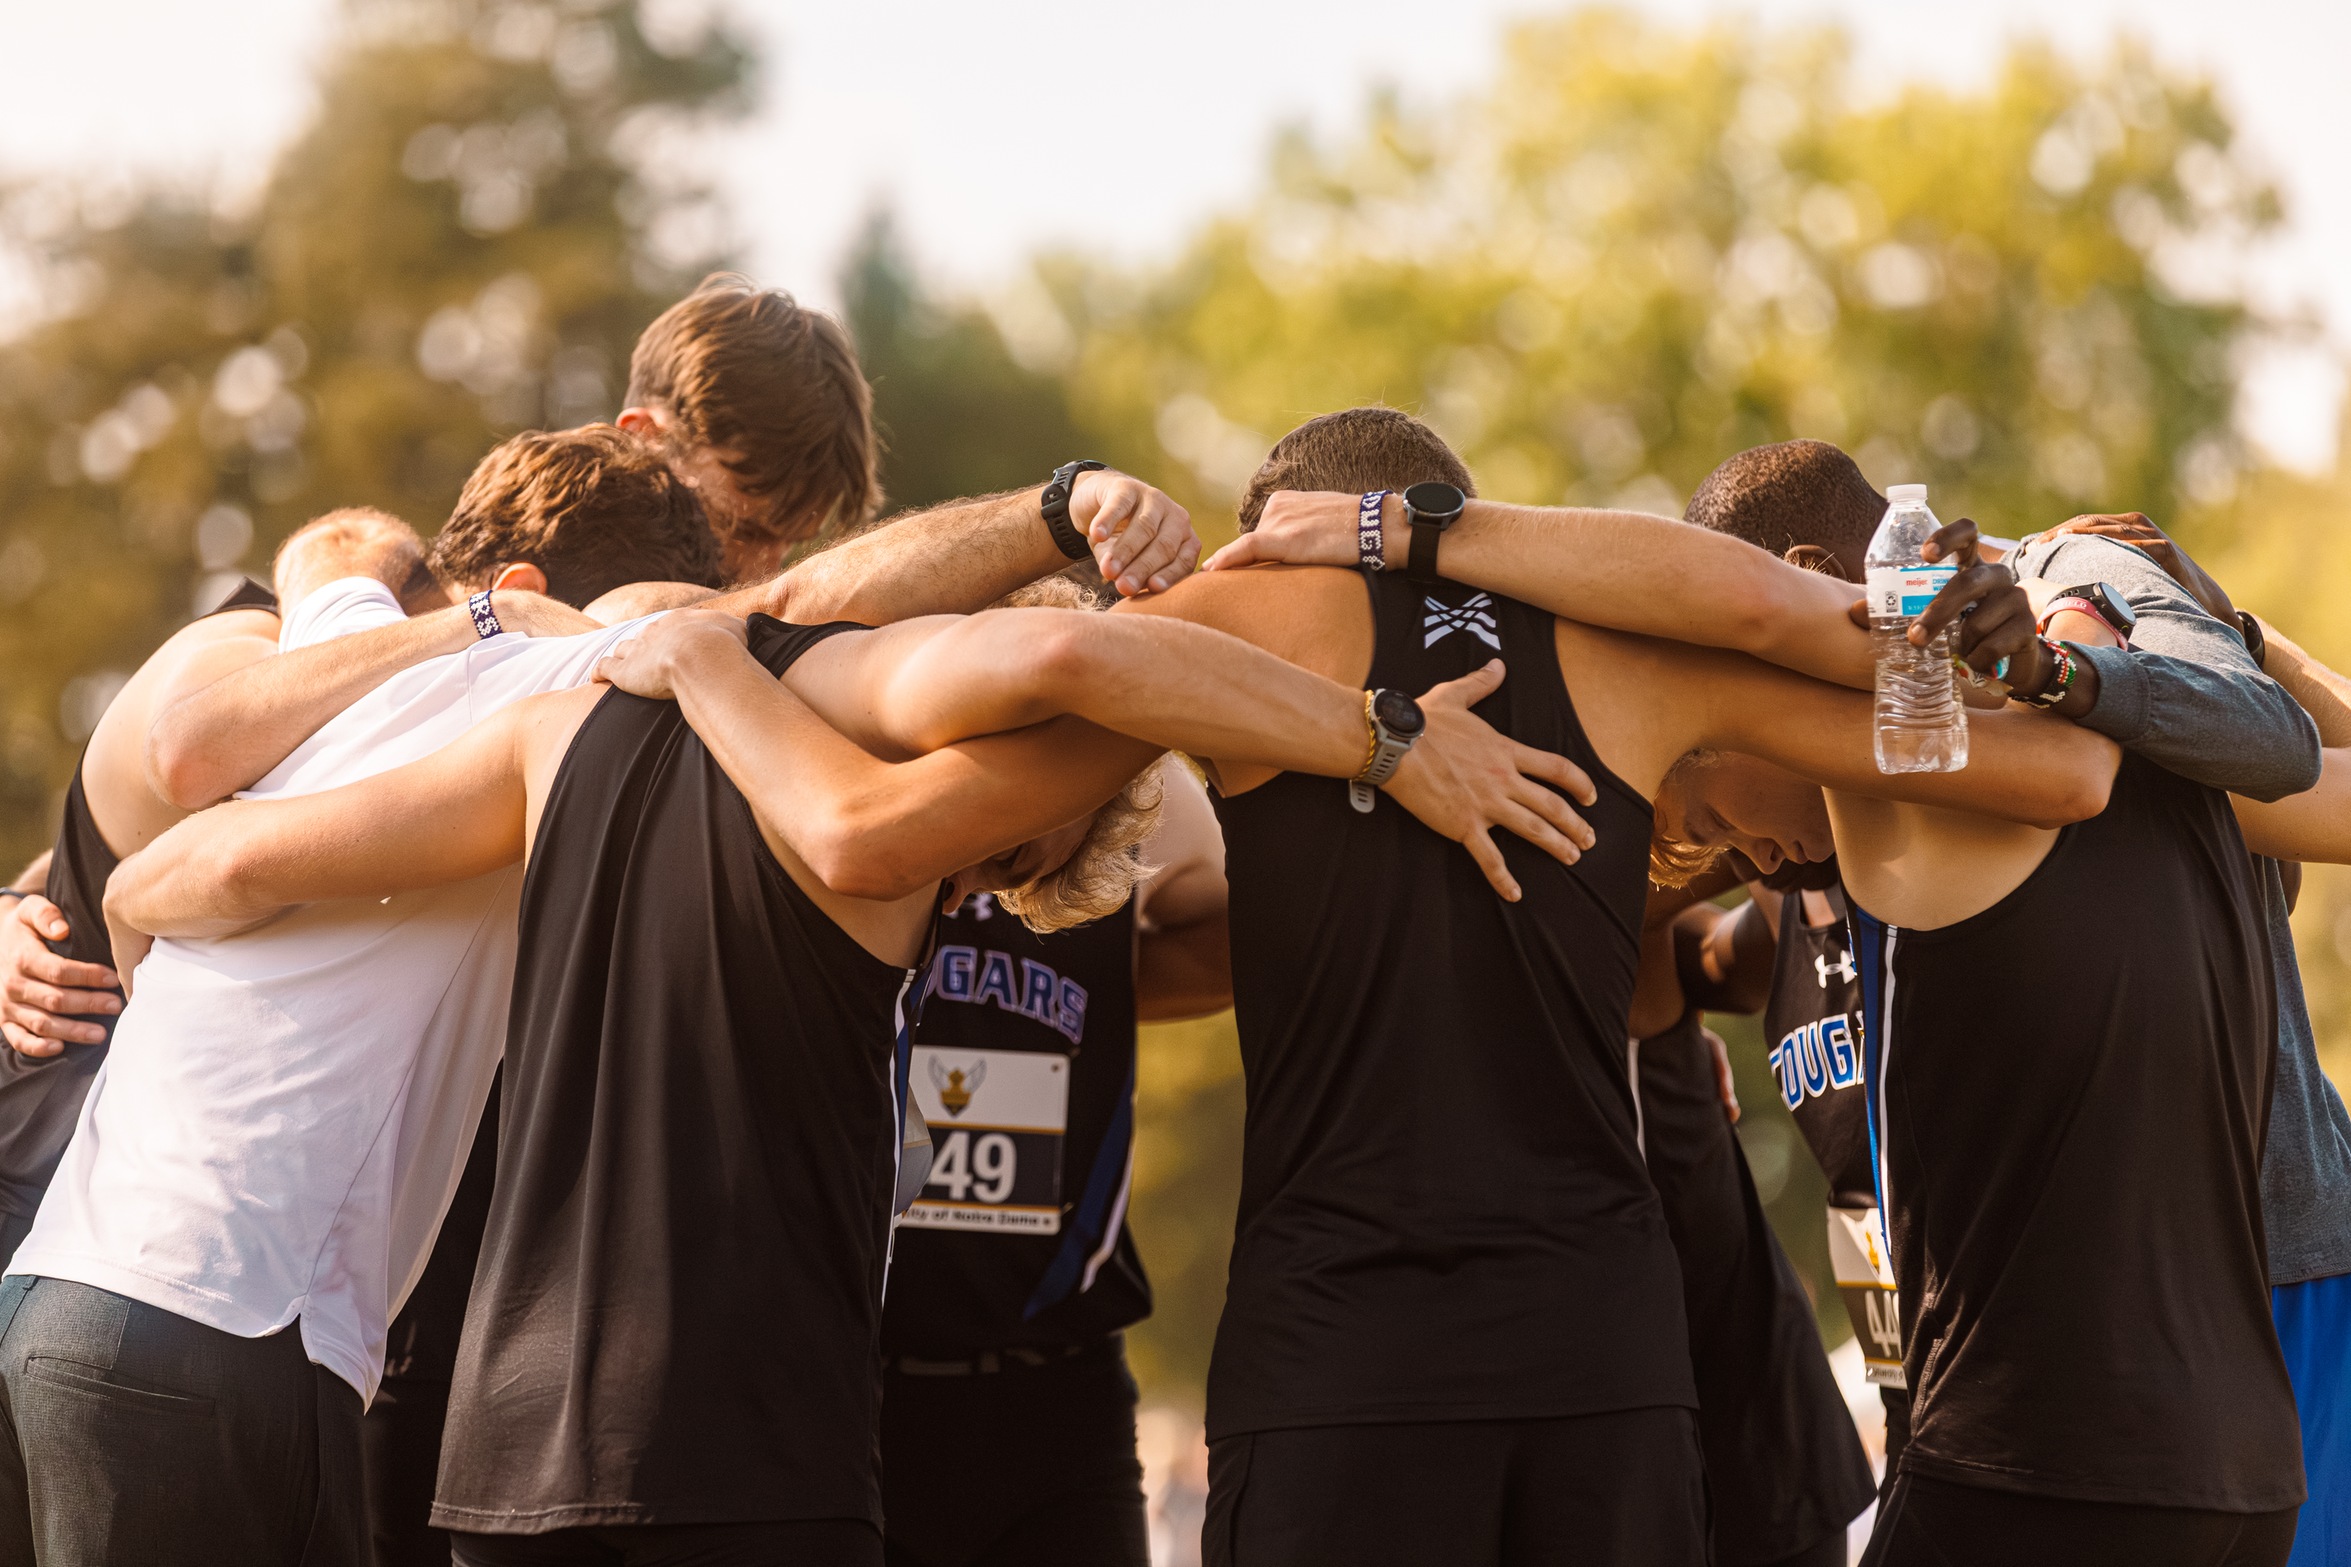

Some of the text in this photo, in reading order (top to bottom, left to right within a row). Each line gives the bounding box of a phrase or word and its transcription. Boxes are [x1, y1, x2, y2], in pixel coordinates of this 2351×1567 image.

[1906, 577, 1928, 587] meijer
[925, 944, 1088, 1044] GARS
[1768, 1010, 1864, 1112] OUG
[926, 1130, 1017, 1203] 49
